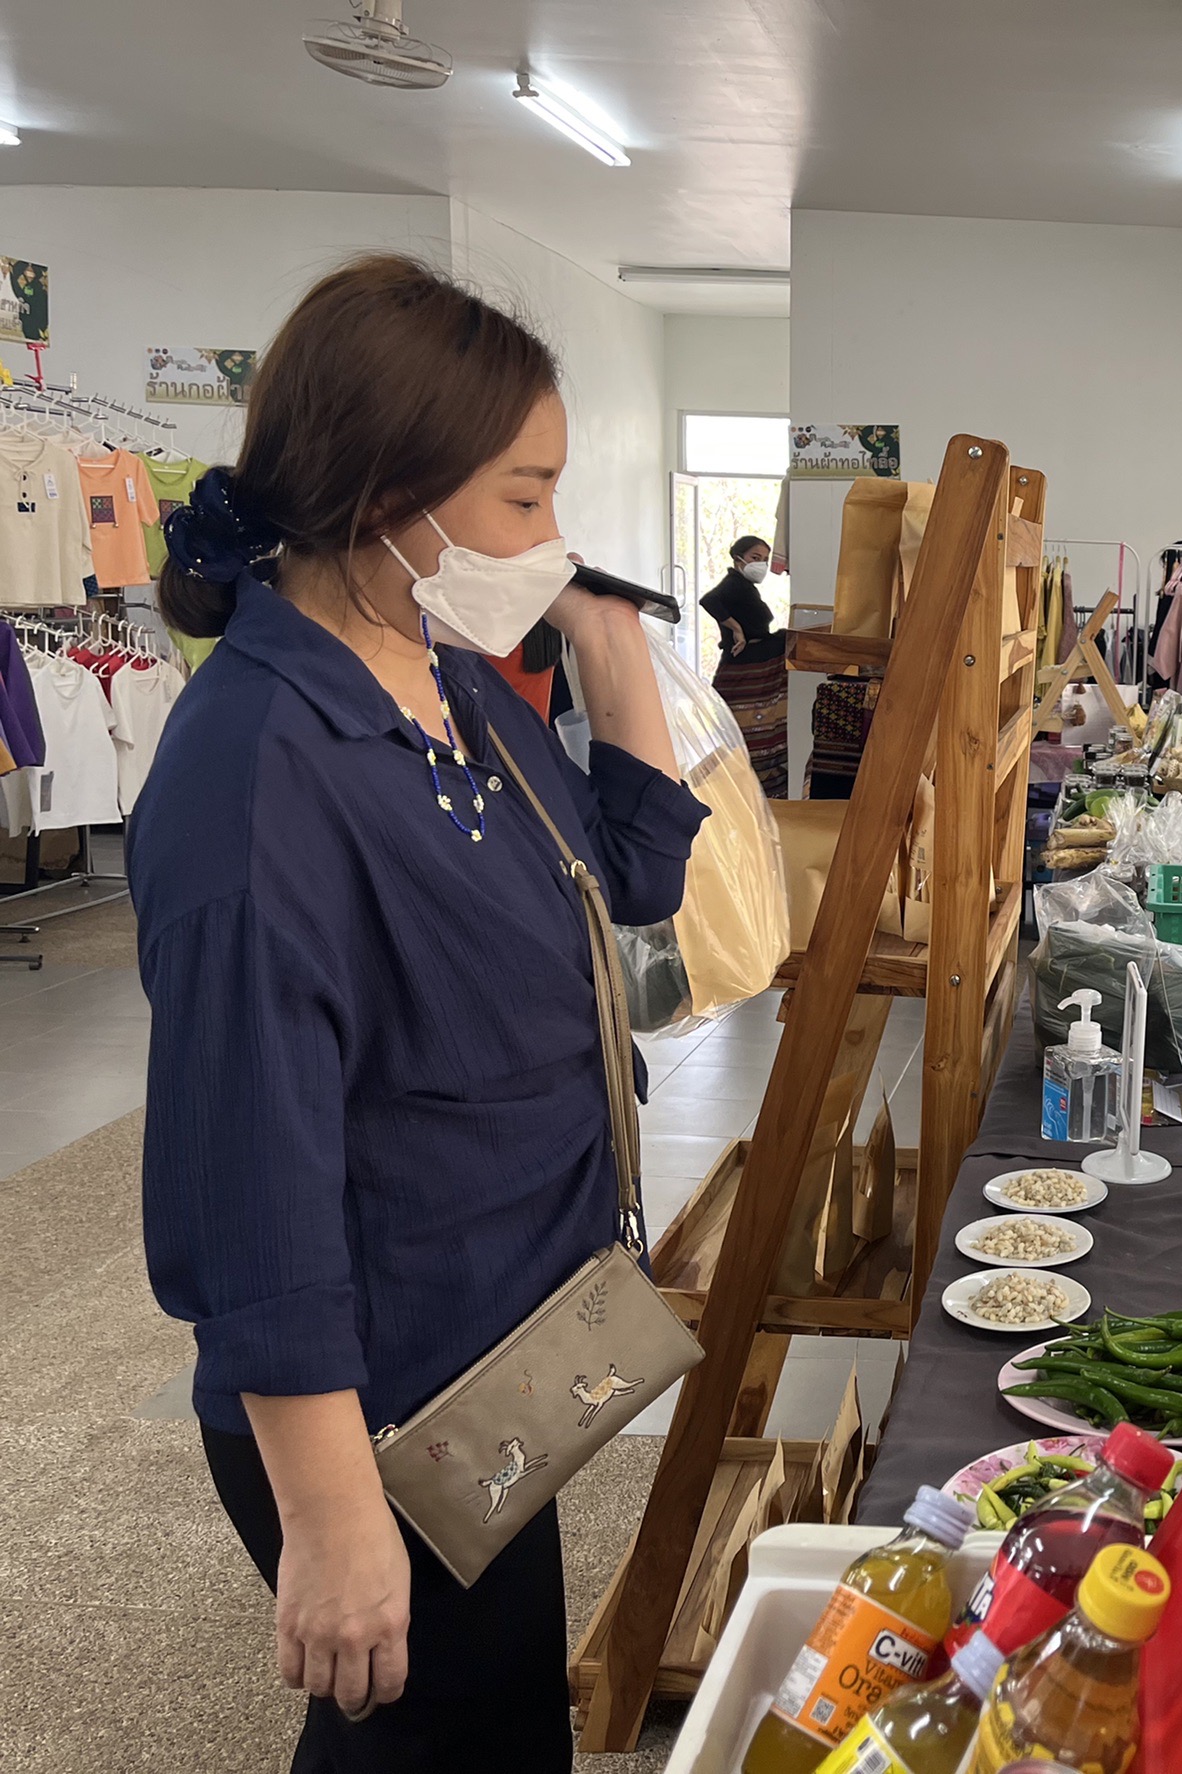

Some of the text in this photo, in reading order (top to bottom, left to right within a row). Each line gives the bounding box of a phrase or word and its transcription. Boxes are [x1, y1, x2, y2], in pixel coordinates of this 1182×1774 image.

[146, 372, 248, 400] ร้านกอฝ้า
[791, 446, 899, 470] ร้านผ้าทอไทลื้อ
[838, 1663, 882, 1704] Ora
